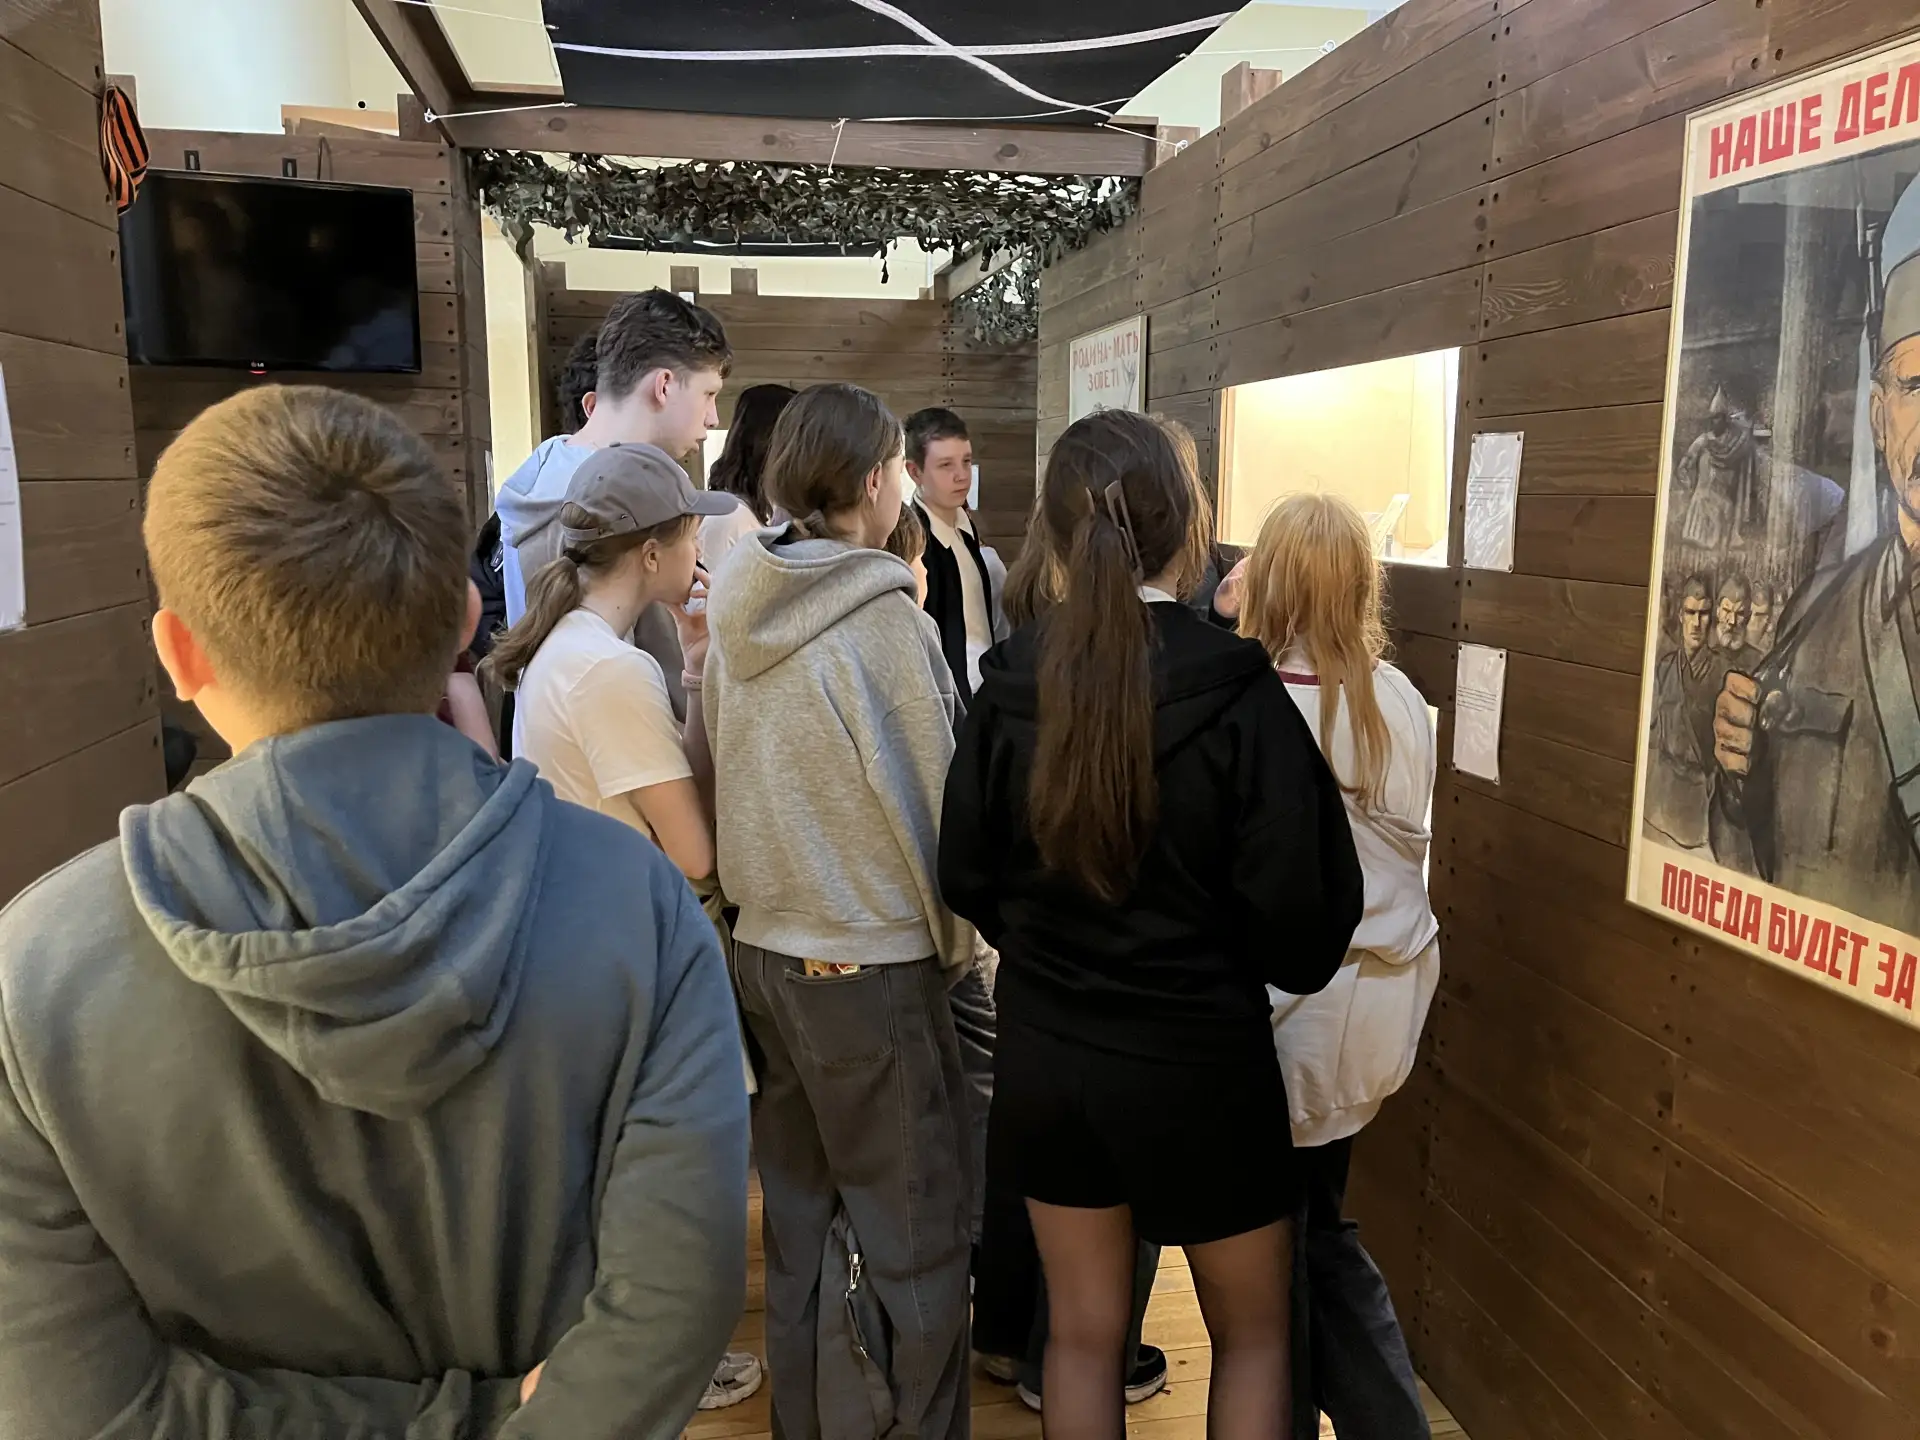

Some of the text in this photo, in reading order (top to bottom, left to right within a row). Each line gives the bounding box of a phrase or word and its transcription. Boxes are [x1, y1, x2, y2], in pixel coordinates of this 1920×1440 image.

[1709, 62, 1920, 179] НАШЕ ДЕЛ
[1661, 862, 1918, 1010] ПОБЕДА БУДЕТ ЗА
